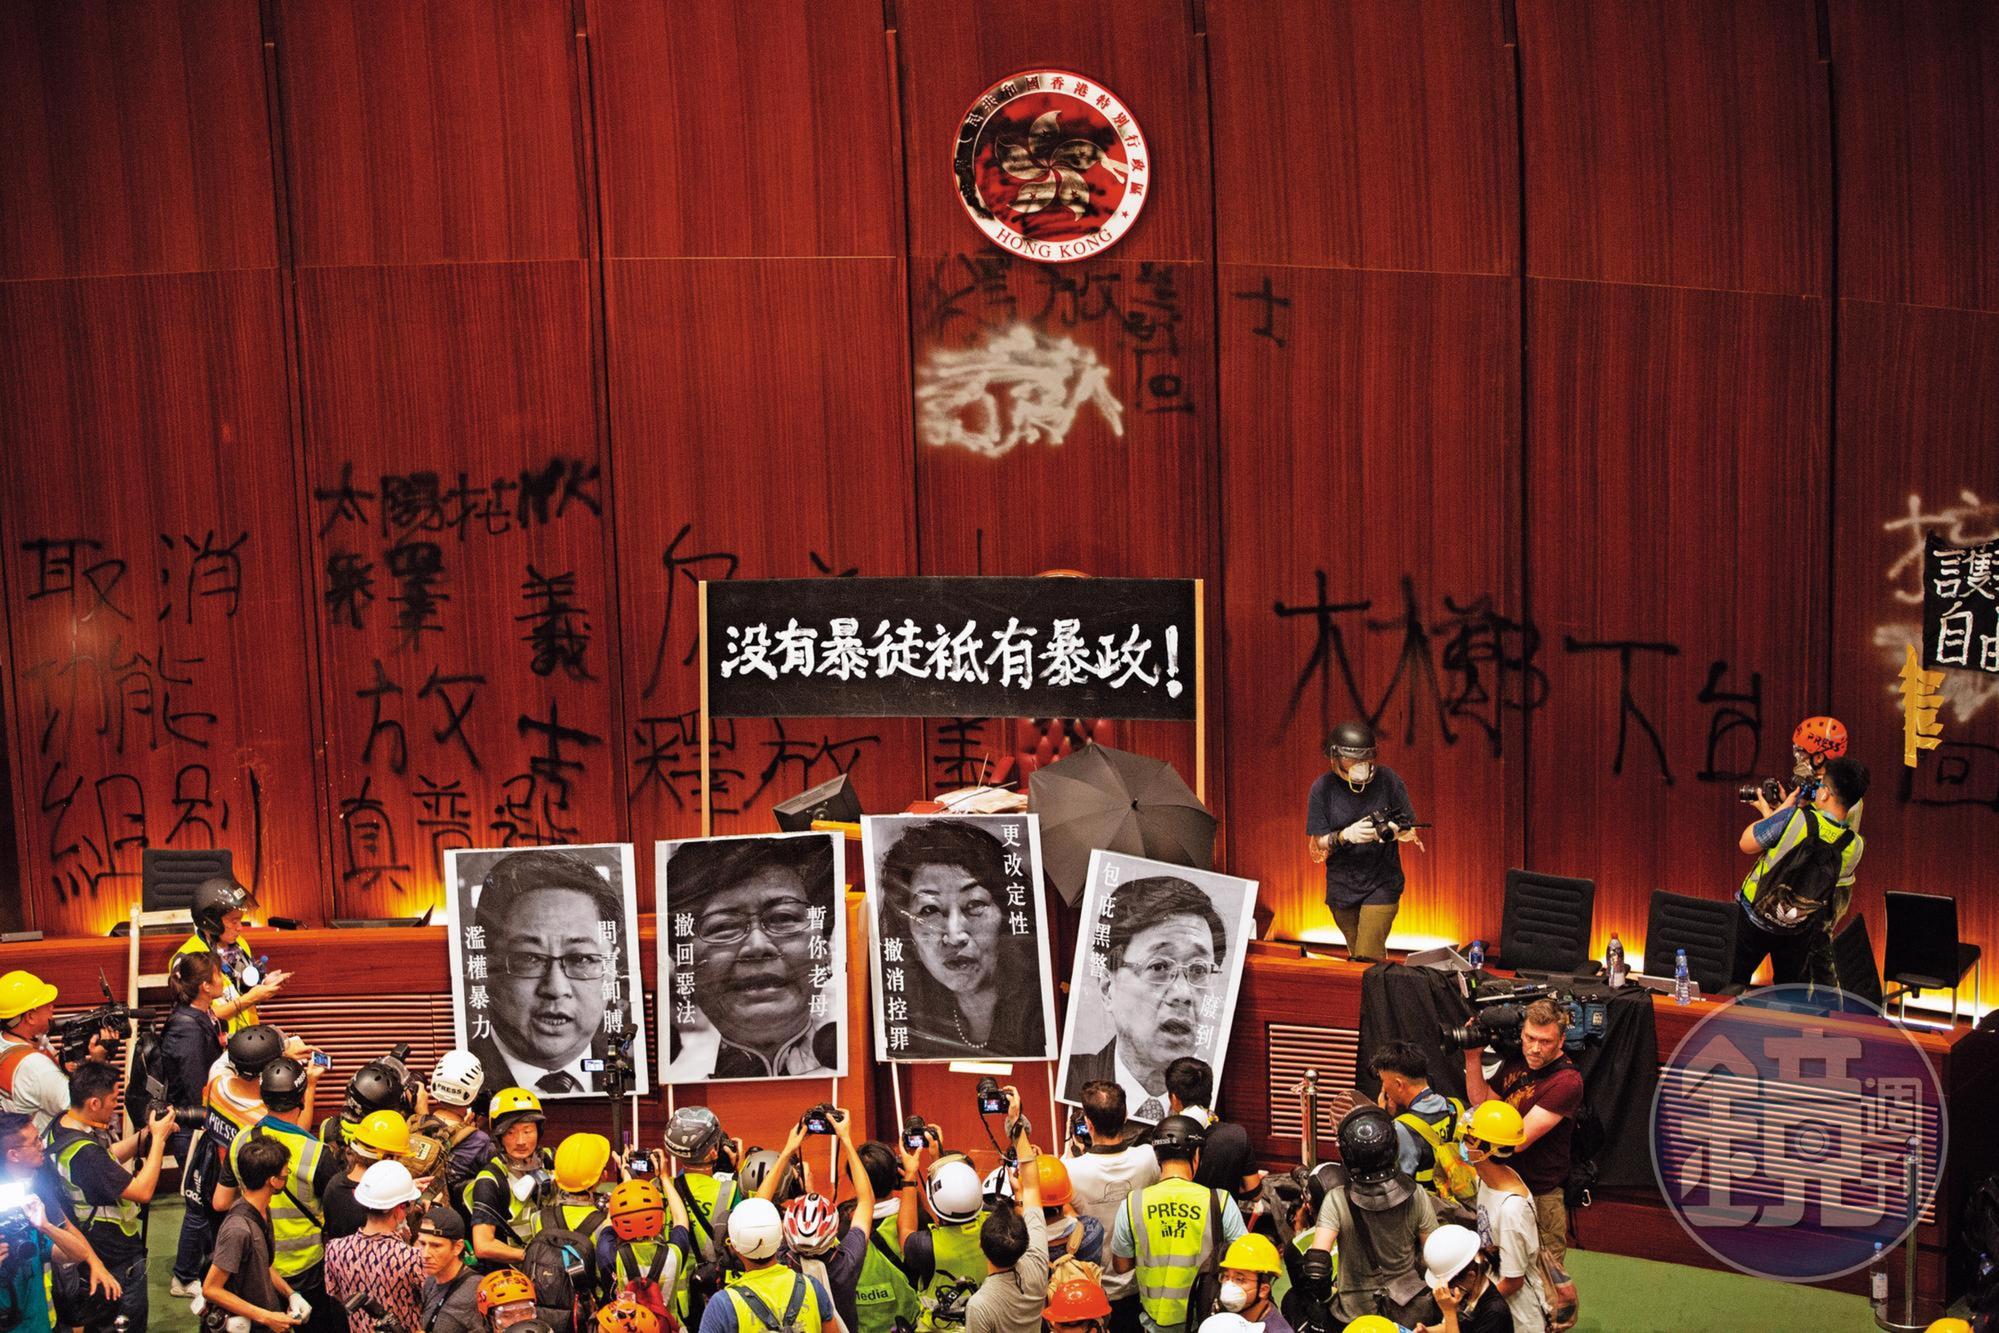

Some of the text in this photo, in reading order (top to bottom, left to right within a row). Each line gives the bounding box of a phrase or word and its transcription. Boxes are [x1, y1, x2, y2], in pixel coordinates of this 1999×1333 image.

[995, 227, 1114, 259] HONG KONG
[22, 529, 250, 624] 取消
[1933, 543, 1999, 599] 護
[1807, 731, 1841, 752] PRESS
[1000, 823, 1029, 936] 更改定性
[1089, 861, 1121, 980] 包庇黑警
[465, 925, 491, 1040] 濫權暴力
[597, 920, 624, 1034] 問責卸膊
[674, 913, 697, 1025] 撤回惡法
[806, 905, 830, 1018] 暫你老母
[883, 937, 910, 1050] 撤消控罪
[436, 1083, 462, 1096] PRESS
[1147, 1202, 1202, 1220] PRESS
